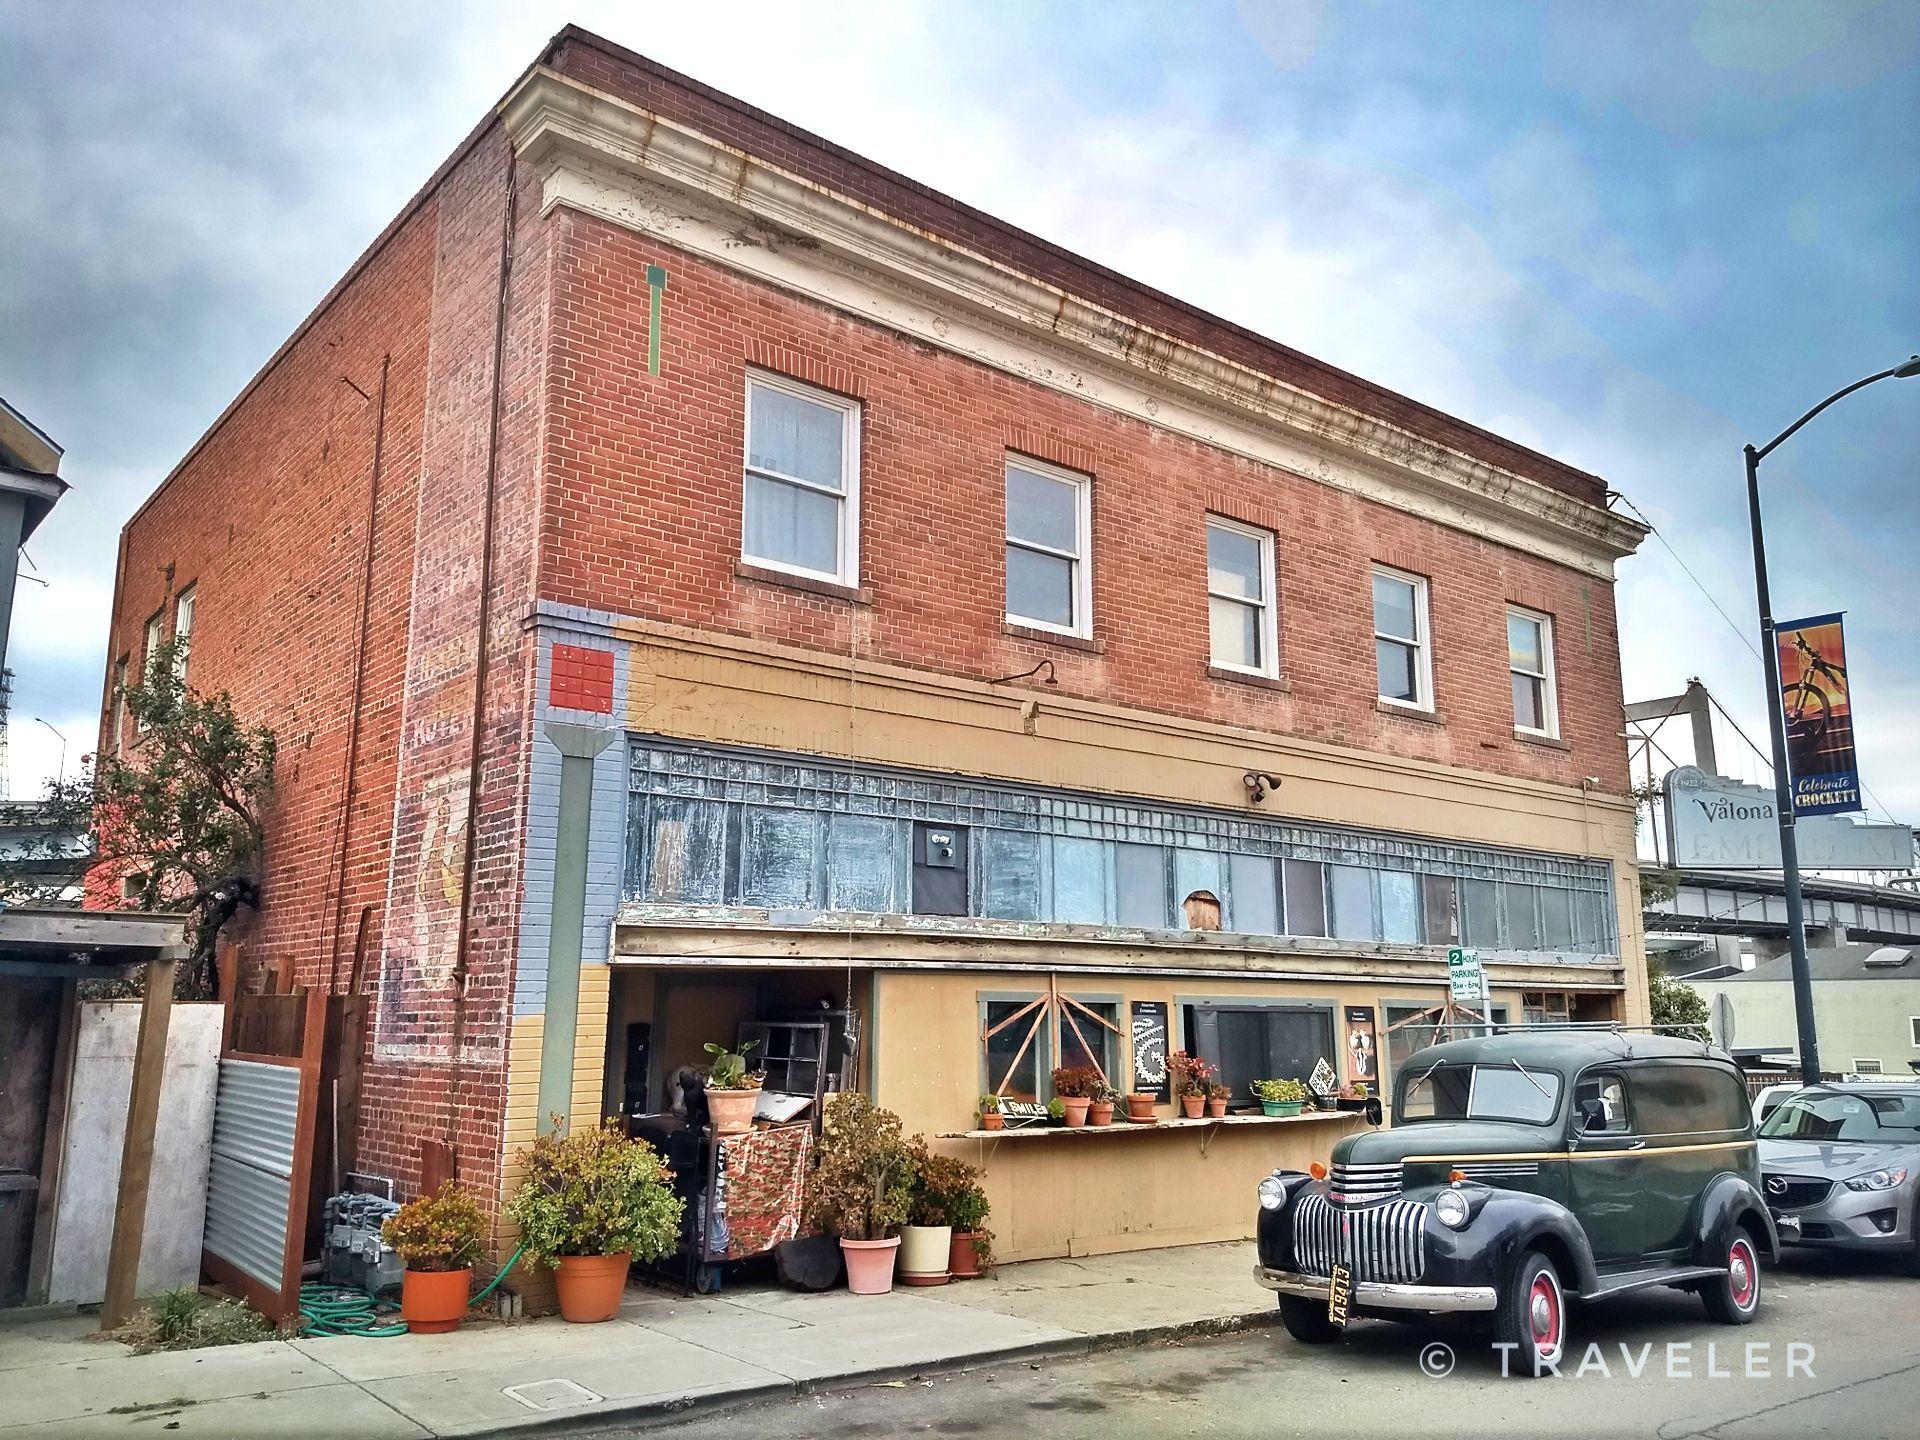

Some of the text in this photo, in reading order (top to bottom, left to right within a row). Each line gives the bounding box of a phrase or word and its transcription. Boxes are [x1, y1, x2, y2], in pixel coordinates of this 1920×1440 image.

[1680, 779, 1699, 788] 1922
[1798, 776, 1851, 793] Celebrate
[1795, 789, 1857, 807] CROCKETT
[1692, 797, 1773, 823] Valona
[1452, 952, 1477, 964] 2 HOUR
[1451, 969, 1479, 979] PARKING
[1333, 1267, 1350, 1327] 1A9413
